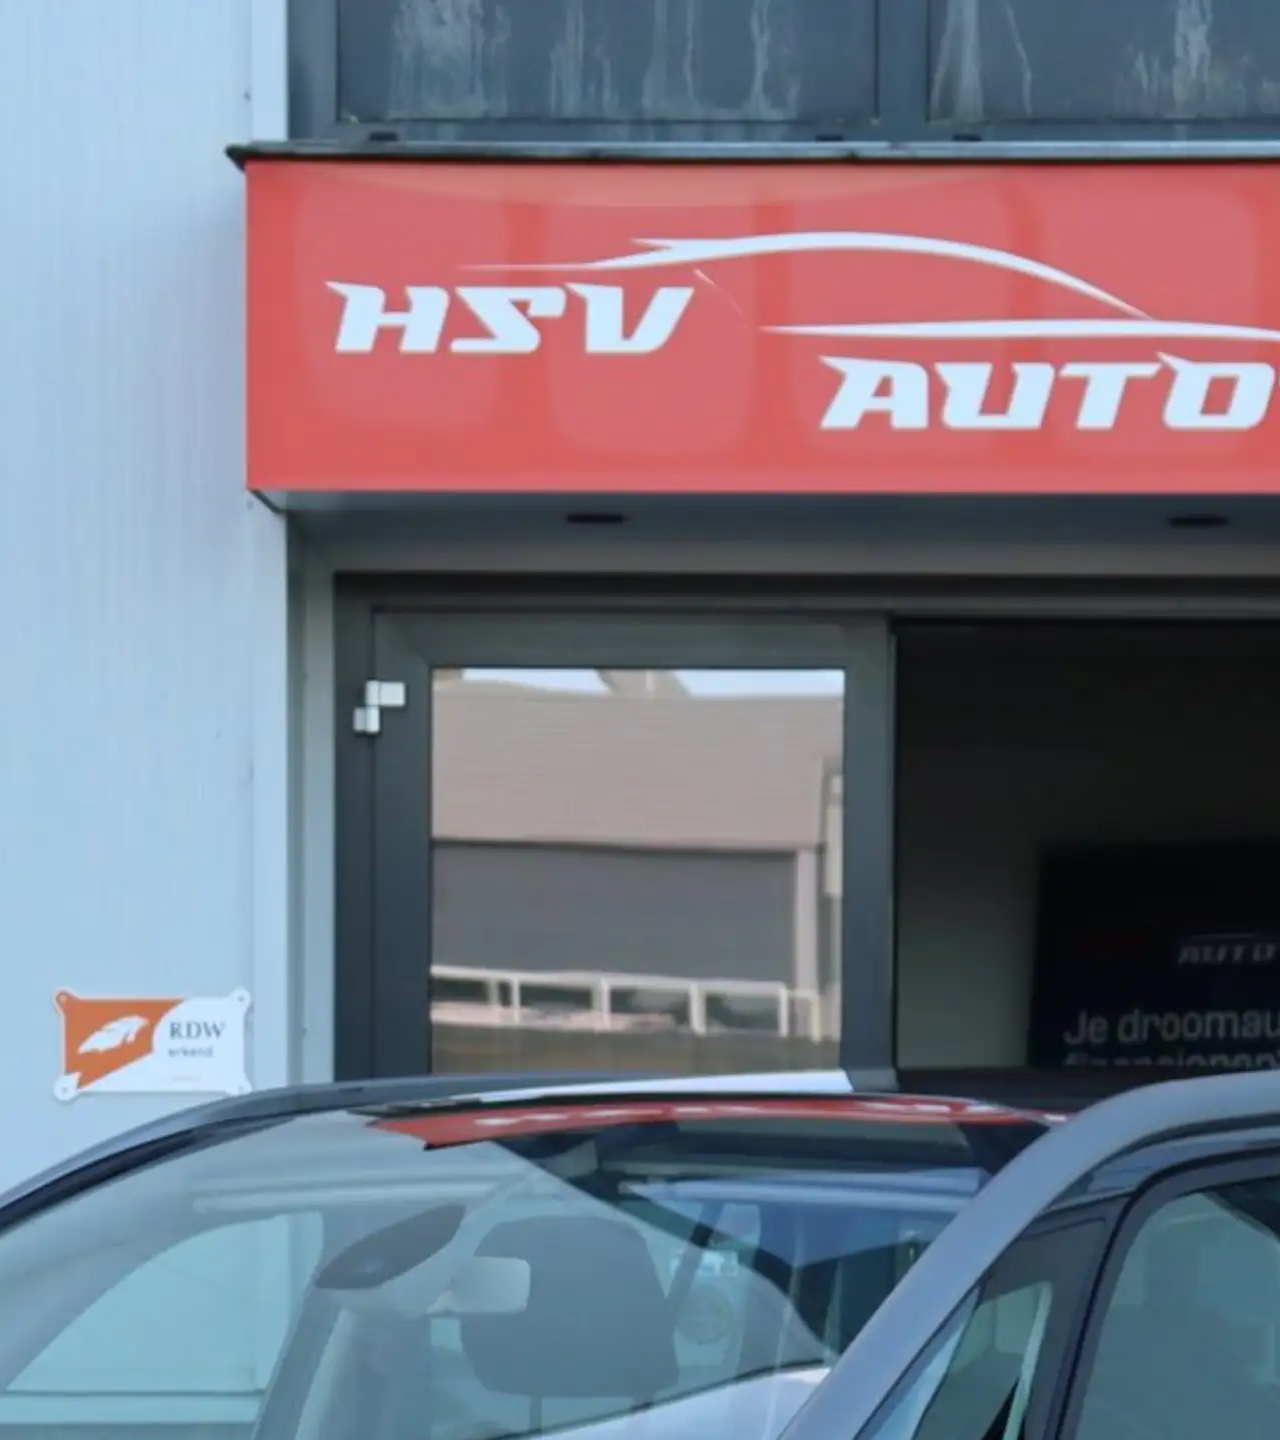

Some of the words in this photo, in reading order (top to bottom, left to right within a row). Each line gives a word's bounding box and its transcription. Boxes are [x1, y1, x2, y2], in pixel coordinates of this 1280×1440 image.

[324, 281, 694, 354] HSV
[169, 1021, 227, 1039] RDW
[1062, 1010, 1109, 1046] Je
